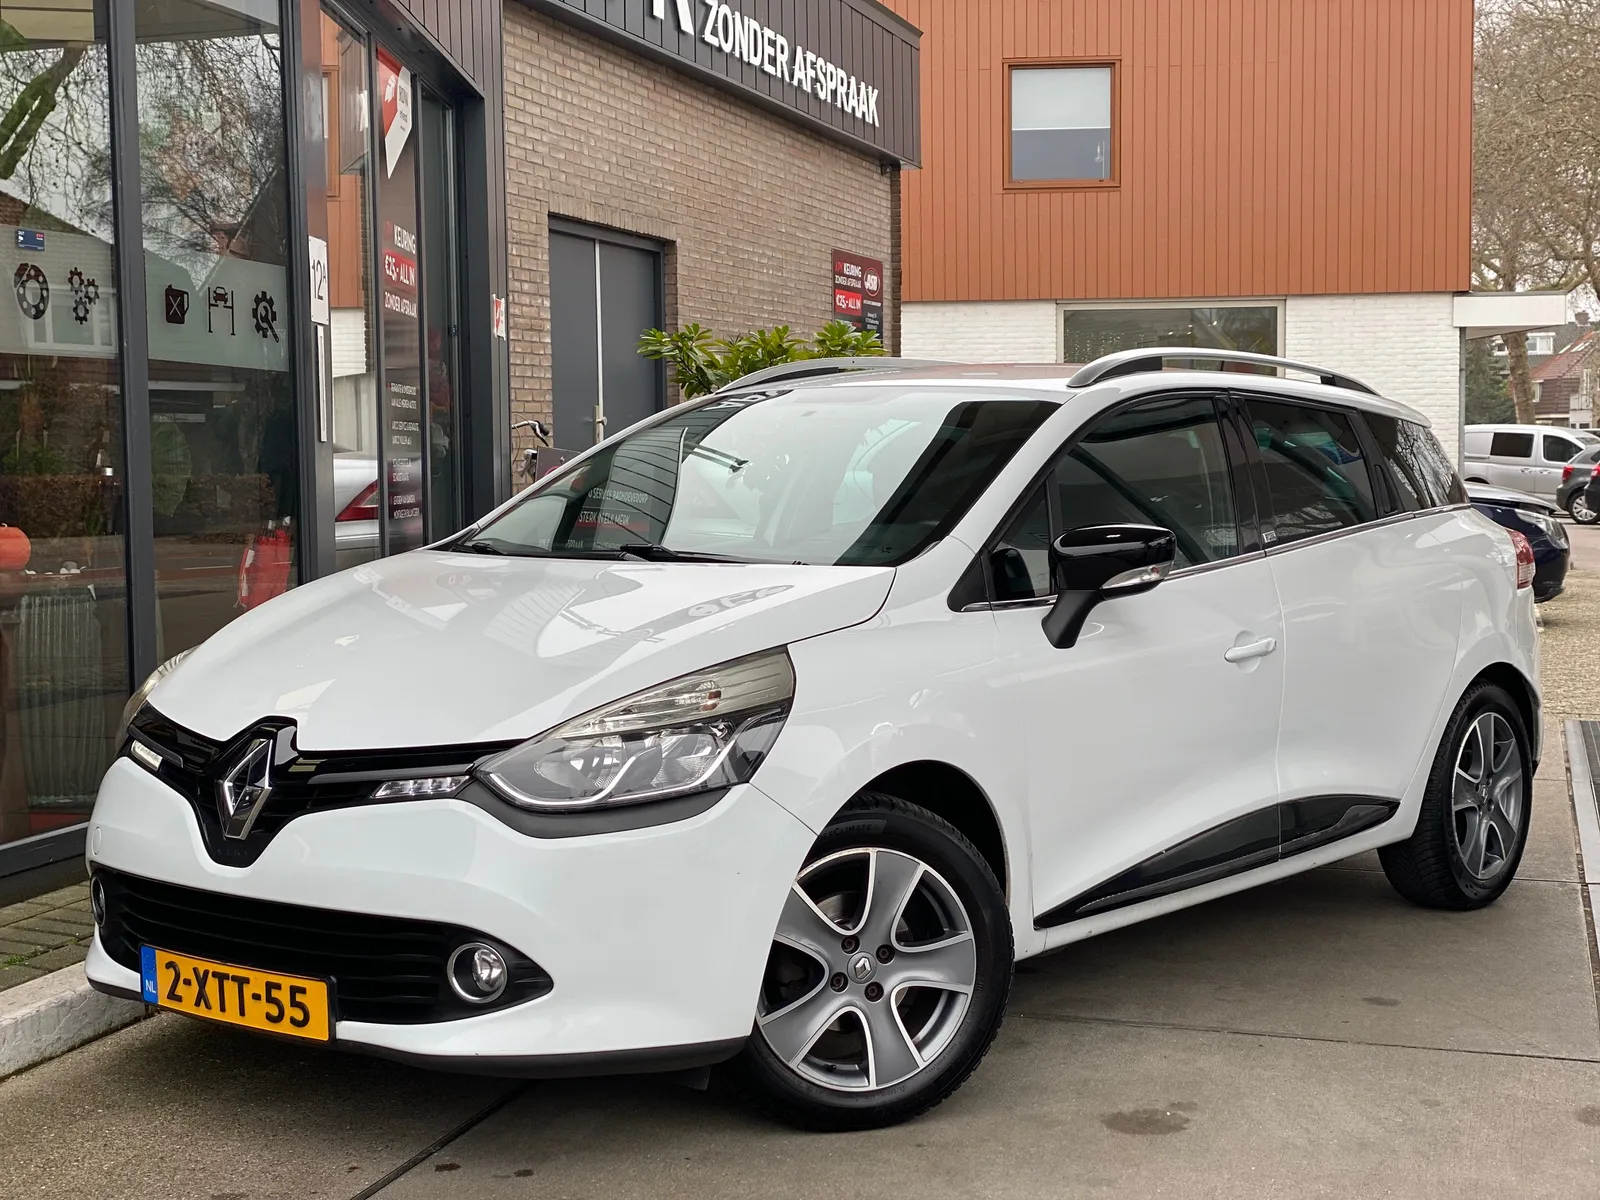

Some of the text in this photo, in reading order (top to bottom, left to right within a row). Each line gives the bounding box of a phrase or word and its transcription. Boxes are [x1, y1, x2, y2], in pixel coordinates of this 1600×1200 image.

[704, 0, 790, 83] ZONDER
[793, 45, 880, 128] AFSPRAAK
[394, 224, 416, 254] KEURING
[400, 262, 409, 285] ALL
[578, 510, 597, 524] STERK
[145, 979, 157, 994] NL
[164, 960, 311, 1029] 2-XTT-55
